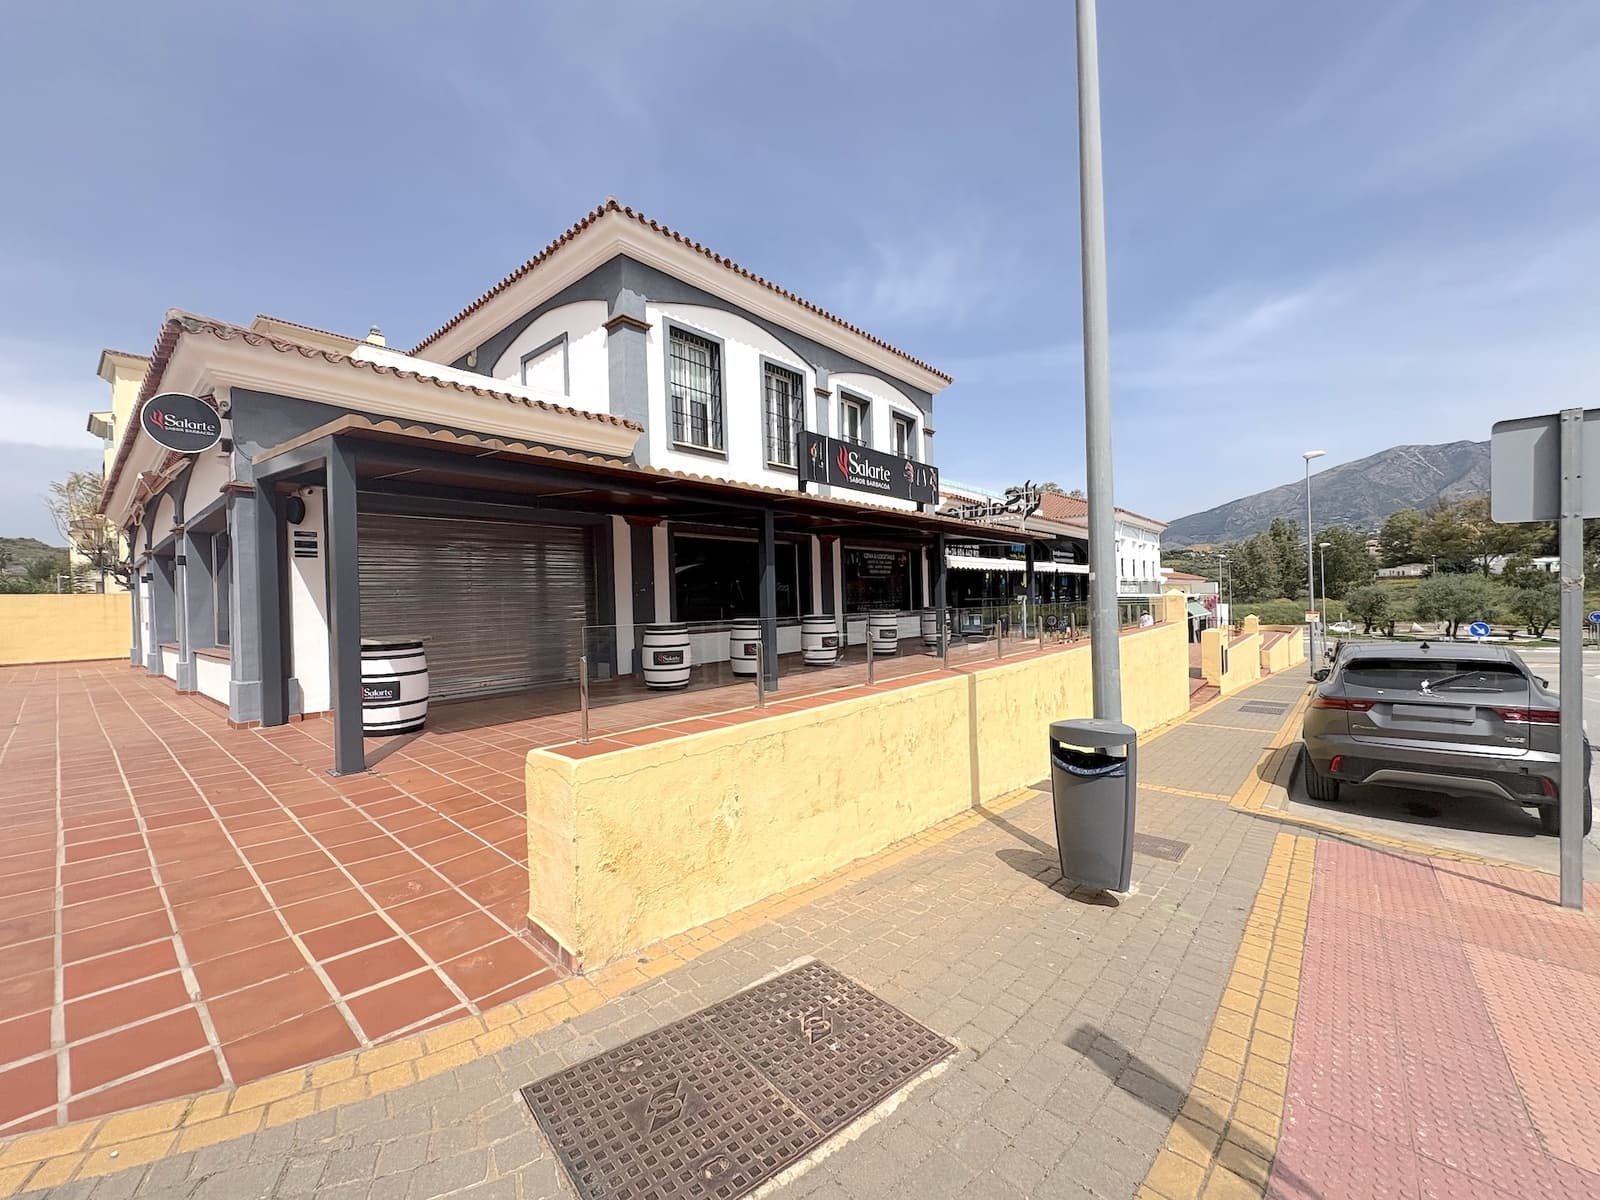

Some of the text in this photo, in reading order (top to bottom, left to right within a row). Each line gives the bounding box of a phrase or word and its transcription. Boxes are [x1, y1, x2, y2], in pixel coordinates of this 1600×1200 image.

[164, 414, 216, 431] Salarte
[848, 451, 891, 482] Salarte
[849, 476, 891, 490] SABOR BARBACOA
[364, 688, 393, 696] Salarte
